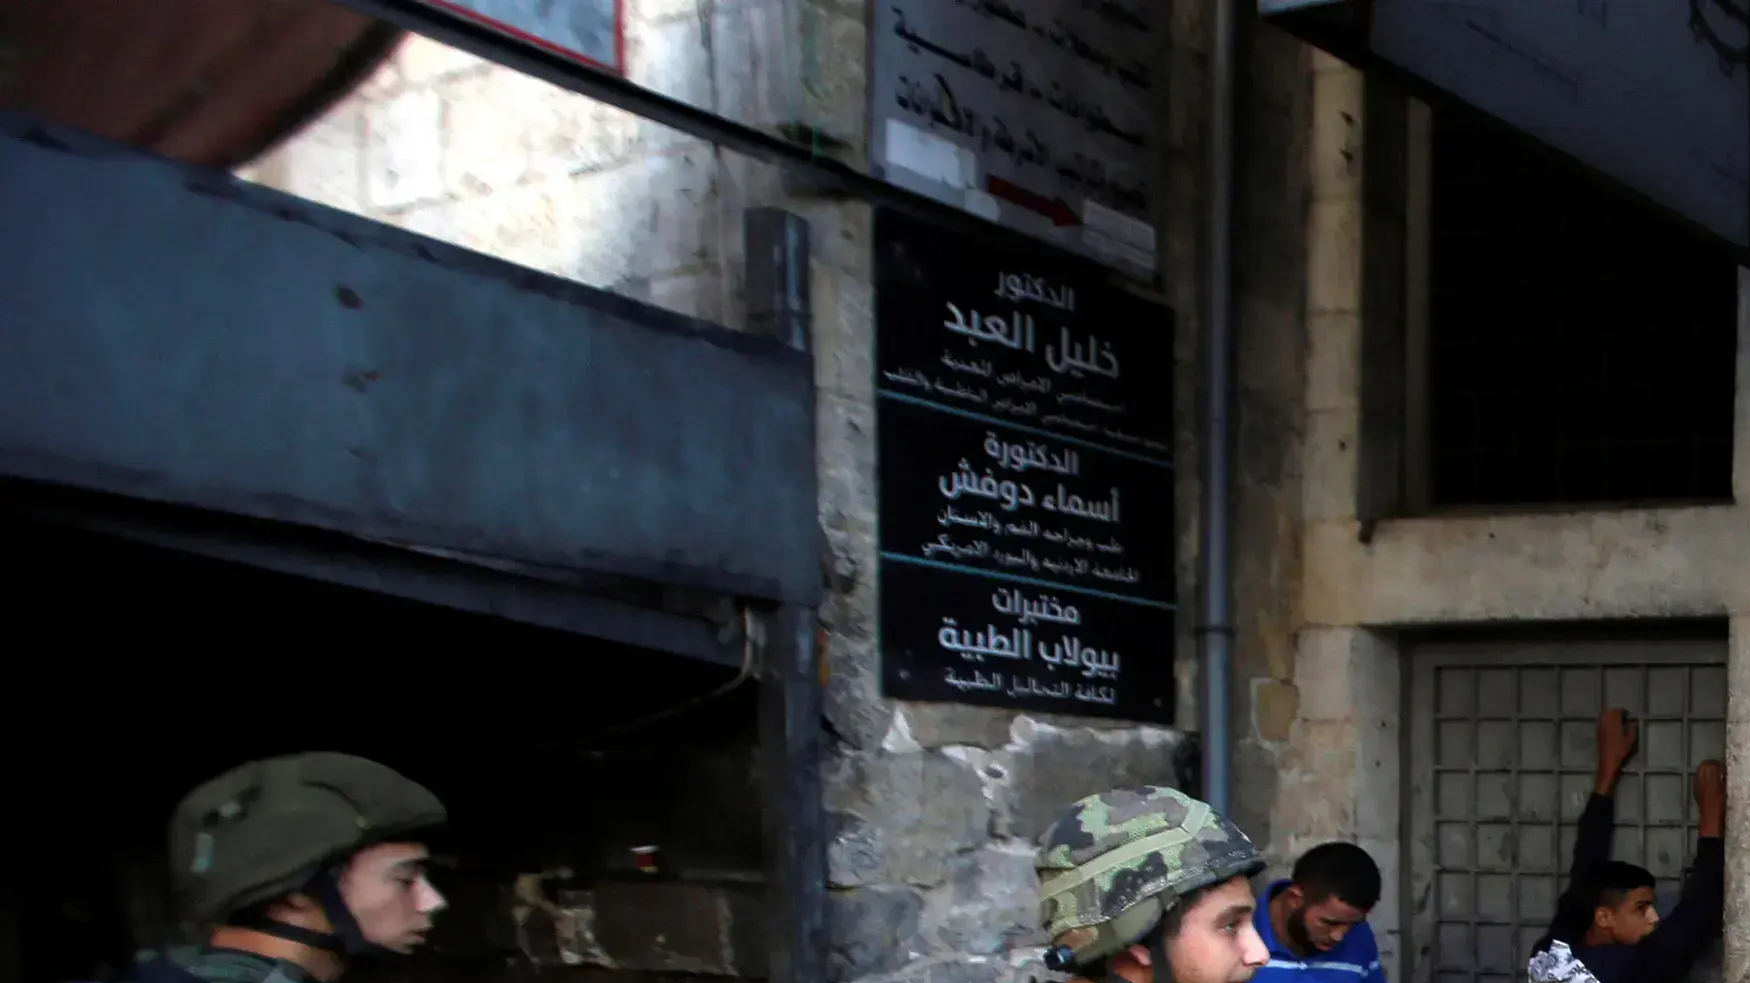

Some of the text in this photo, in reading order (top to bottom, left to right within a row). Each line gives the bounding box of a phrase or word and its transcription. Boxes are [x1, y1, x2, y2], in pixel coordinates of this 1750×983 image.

[993, 269, 1077, 312] الدكتور
[943, 300, 1123, 380] خليل العبد
[983, 430, 1081, 478] الدكتورة
[1040, 481, 1123, 525] أسماء
[991, 585, 1083, 627] مختبرات
[937, 615, 1123, 682] بيولاب الطبية
[943, 666, 1004, 693] الطبية
